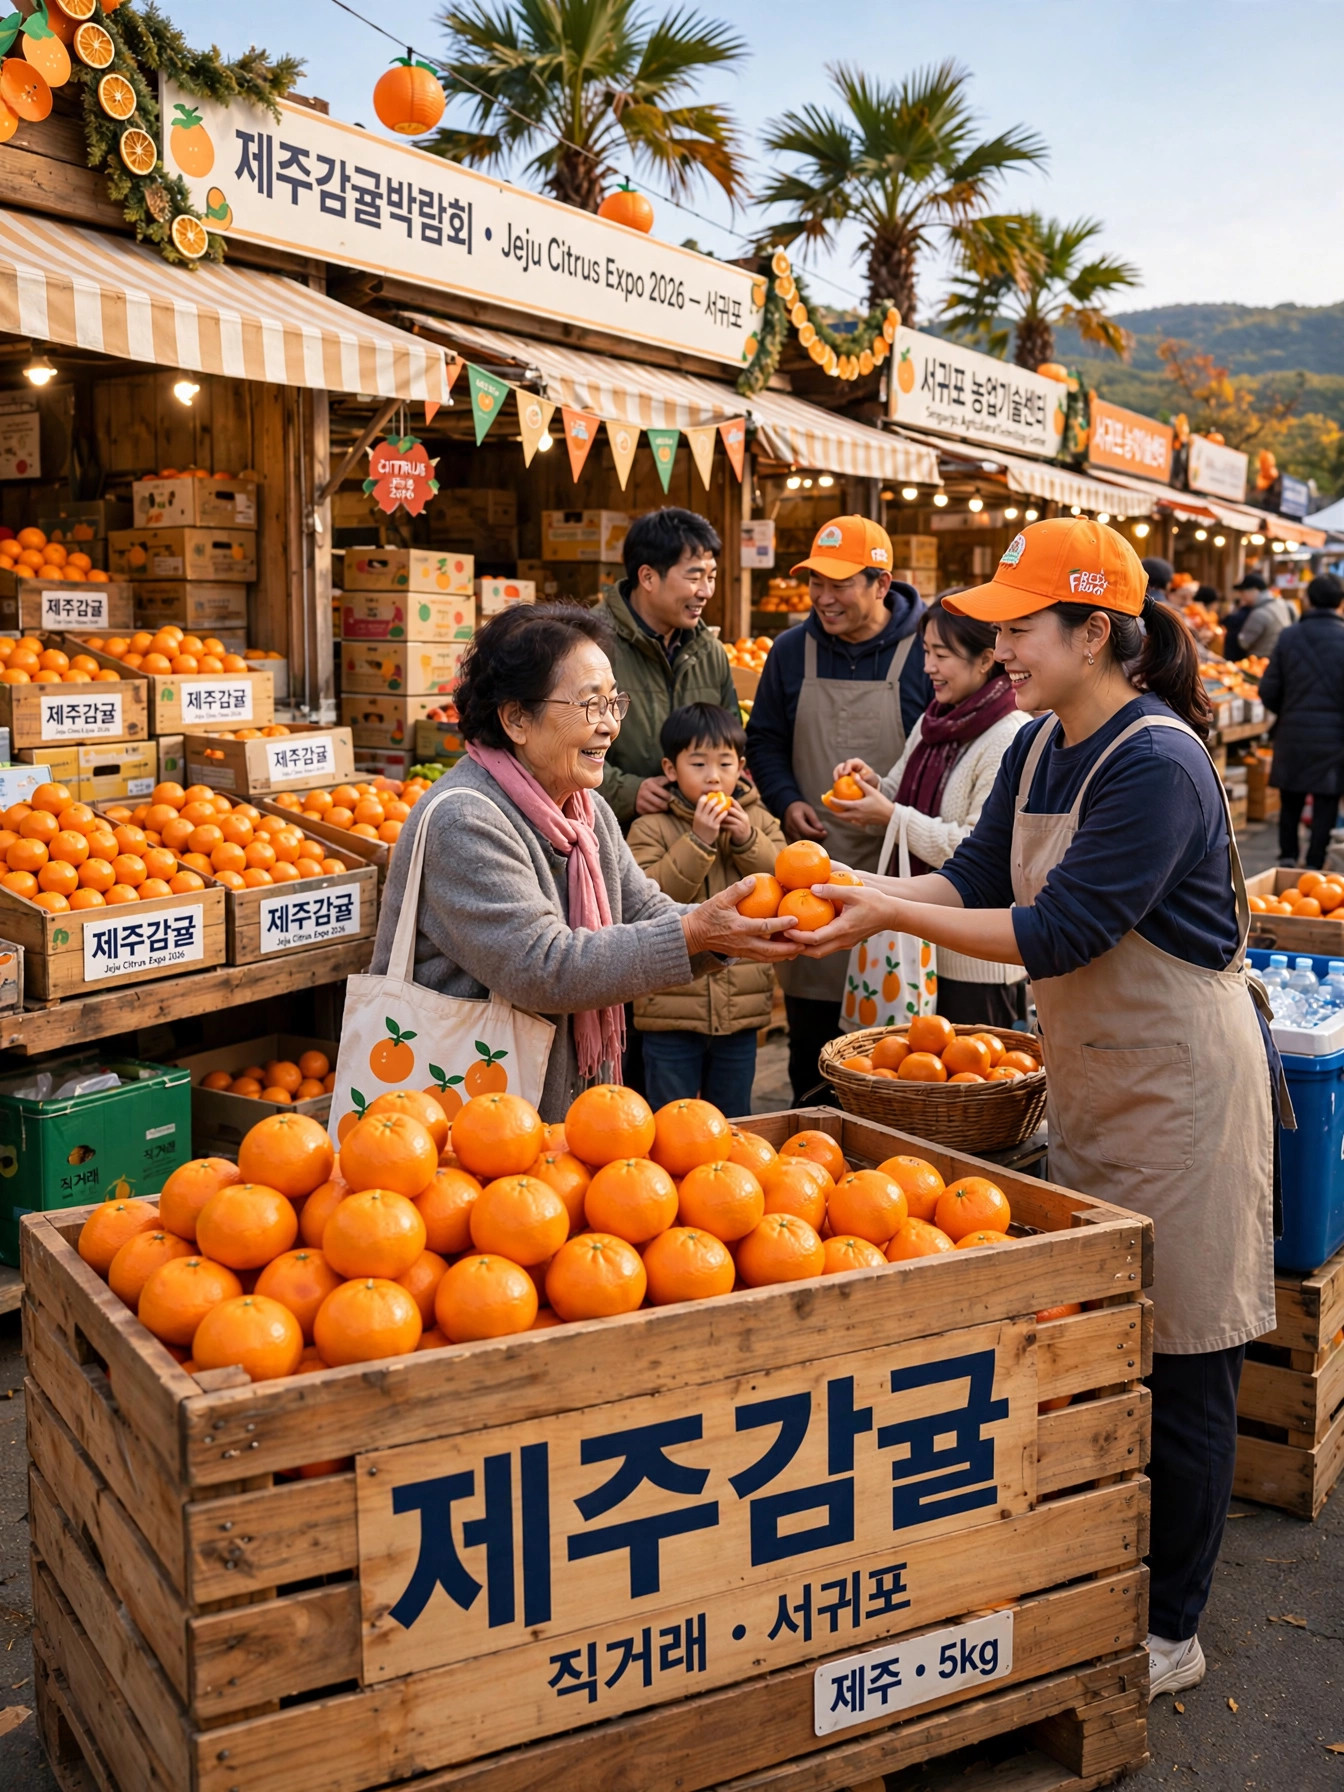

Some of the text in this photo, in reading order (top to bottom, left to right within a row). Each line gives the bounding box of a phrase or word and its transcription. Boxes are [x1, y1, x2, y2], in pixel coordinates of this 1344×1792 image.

[235, 128, 472, 255] 제주감귤박람회
[501, 222, 542, 272] Jeju
[548, 237, 600, 284] Citrus
[606, 257, 644, 302] Expo
[649, 271, 685, 310] 2026
[705, 291, 742, 329] 서귀포
[921, 357, 966, 406] 서귀포
[46, 598, 103, 617] 제주감귤
[46, 702, 116, 725] 제주감귤
[187, 689, 246, 710] 제주감귤
[274, 745, 328, 768] 제주감귤
[267, 893, 354, 933] 제주감귤
[92, 914, 196, 959] 제주감귤
[104, 962, 120, 974] Jeju
[61, 1167, 99, 1190] 직거래
[388, 1348, 1010, 1631] 제주감귤
[547, 1612, 707, 1703] 직거래
[767, 1562, 911, 1643] 서귀포
[829, 1656, 901, 1713] 제주
[938, 1637, 999, 1679] 5kg
